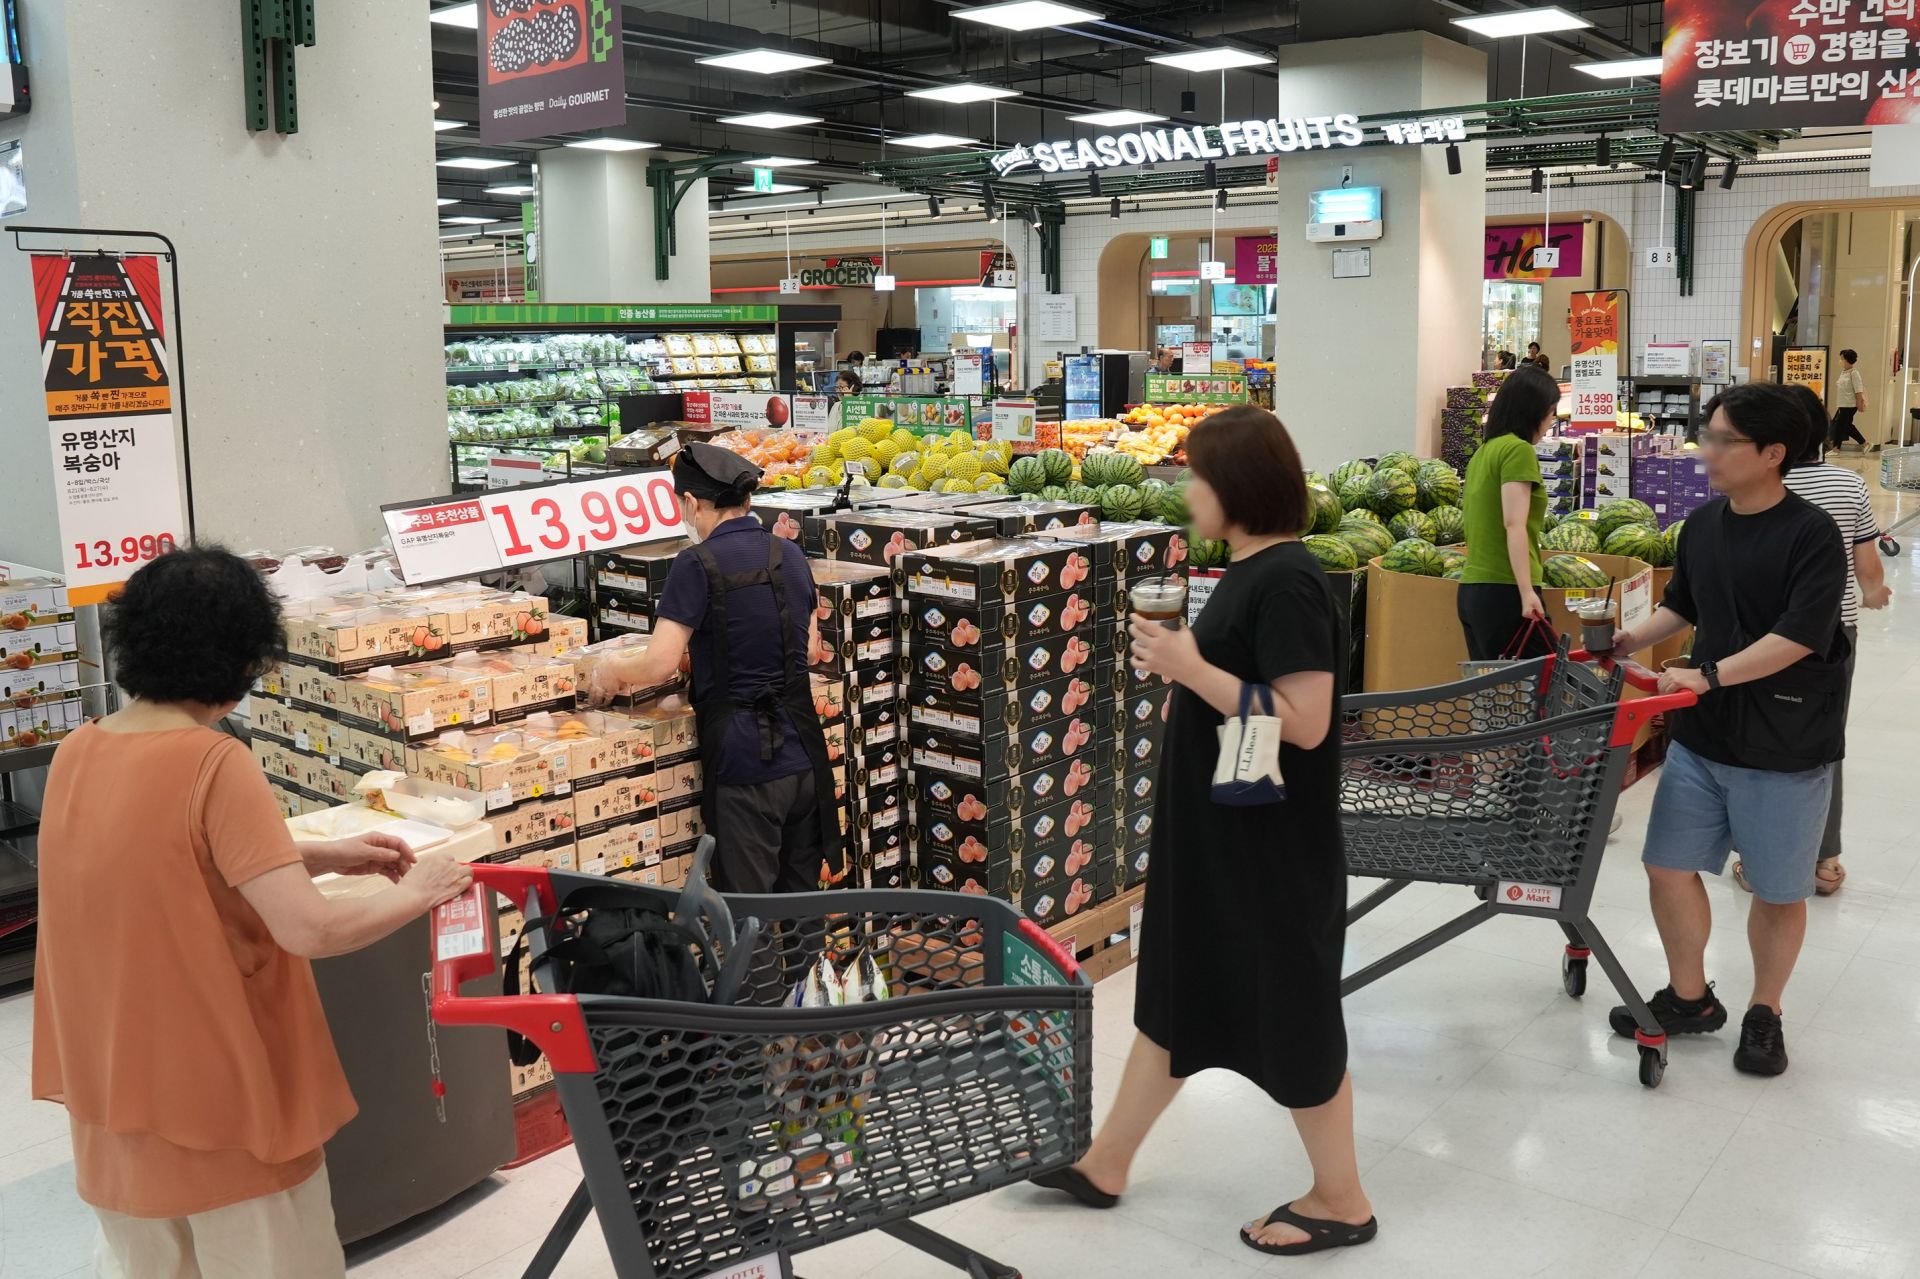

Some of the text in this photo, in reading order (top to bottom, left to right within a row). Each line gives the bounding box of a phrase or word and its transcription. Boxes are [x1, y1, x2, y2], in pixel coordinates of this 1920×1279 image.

[1694, 28, 1910, 69] 장보기 경험을
[1694, 70, 1870, 108] 롯데마트만의
[549, 96, 567, 109] Daily
[568, 88, 610, 107] GOURMET
[990, 113, 1466, 173] Fresh SEASONAL FRUITS 계절과일
[1546, 253, 1553, 263] 7
[1651, 252, 1658, 263] 8
[1667, 252, 1672, 263] 8
[800, 266, 880, 286] GROCERY
[66, 301, 143, 338] 직진
[619, 308, 633, 319] 인증
[635, 308, 656, 319] 농산물
[1576, 315, 1613, 328] 풍요로운
[1575, 327, 1613, 339] 가을맞이
[57, 339, 162, 383] 가격
[1575, 360, 1602, 368] 유명산지
[121, 391, 147, 399] 가격으로
[1579, 393, 1613, 404] 14,990
[70, 403, 99, 411] 장바구니
[1575, 405, 1613, 415] /15,990
[60, 427, 136, 452] 유명산지
[63, 451, 121, 474] 복숭아
[436, 506, 480, 523] 추천상품
[492, 478, 682, 557] 13,990
[400, 537, 415, 545] GAP
[74, 532, 175, 569] 13,990
[956, 763, 962, 771] 11
[1526, 894, 1551, 903] Mart
